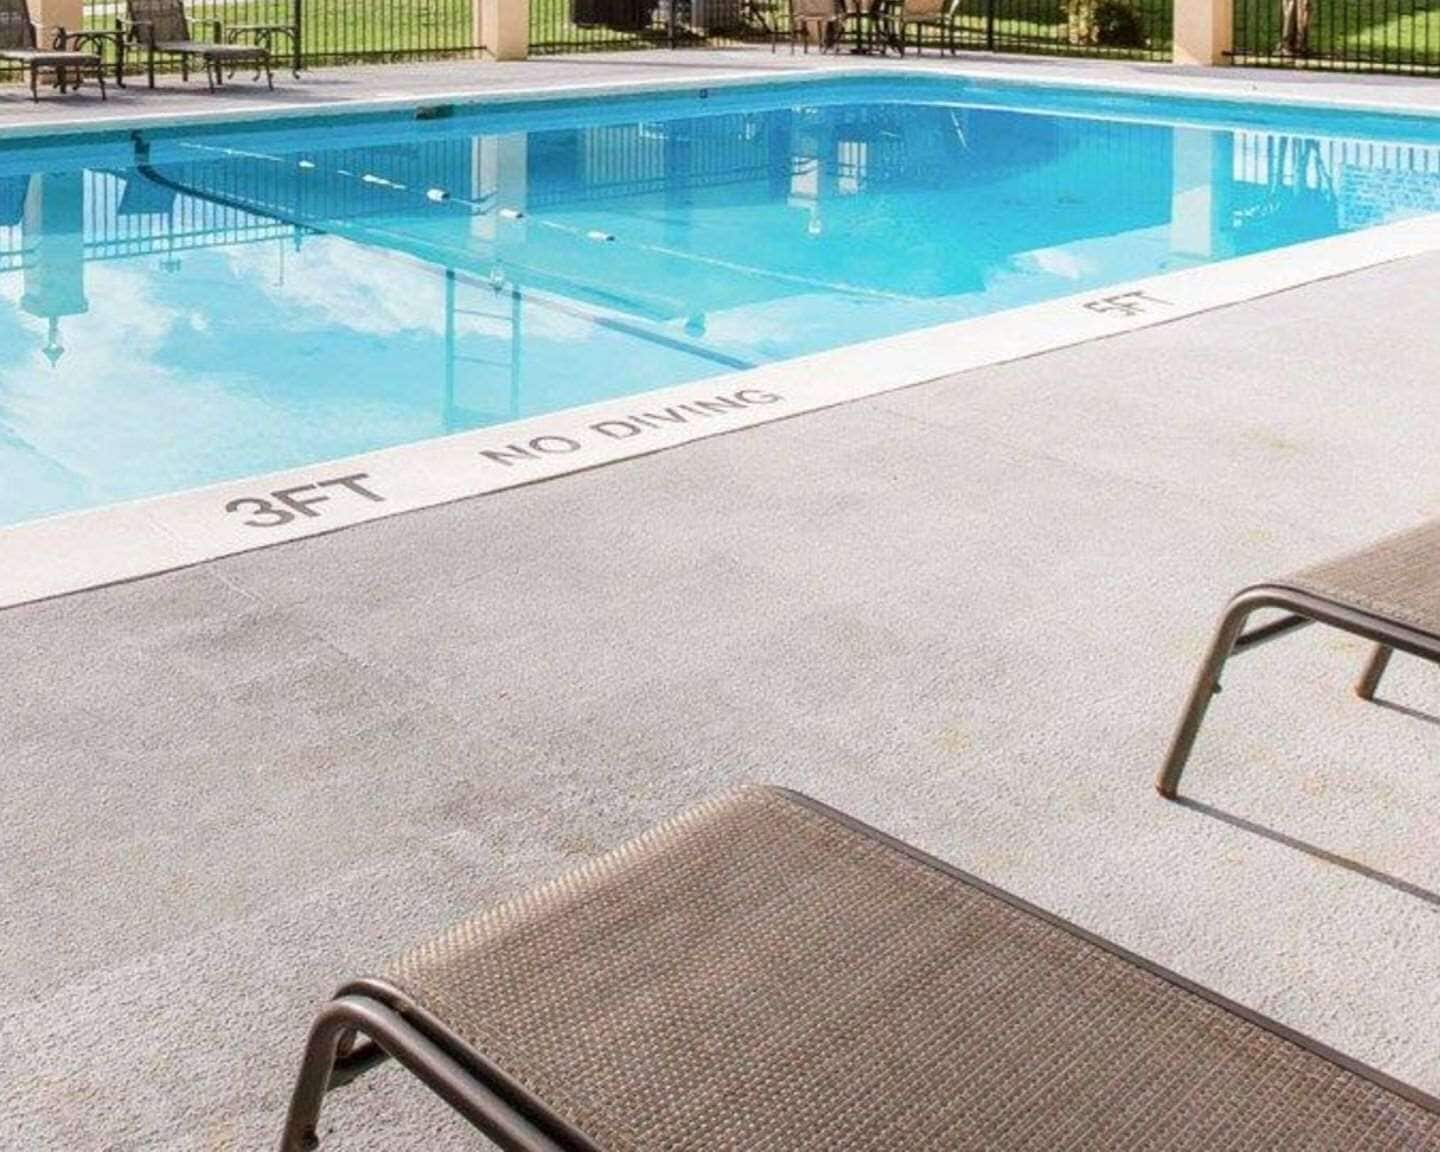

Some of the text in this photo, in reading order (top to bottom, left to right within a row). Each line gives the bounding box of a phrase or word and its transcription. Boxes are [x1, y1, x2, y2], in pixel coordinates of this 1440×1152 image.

[480, 389, 783, 466] NO DIVING
[225, 473, 386, 528] 3FT
